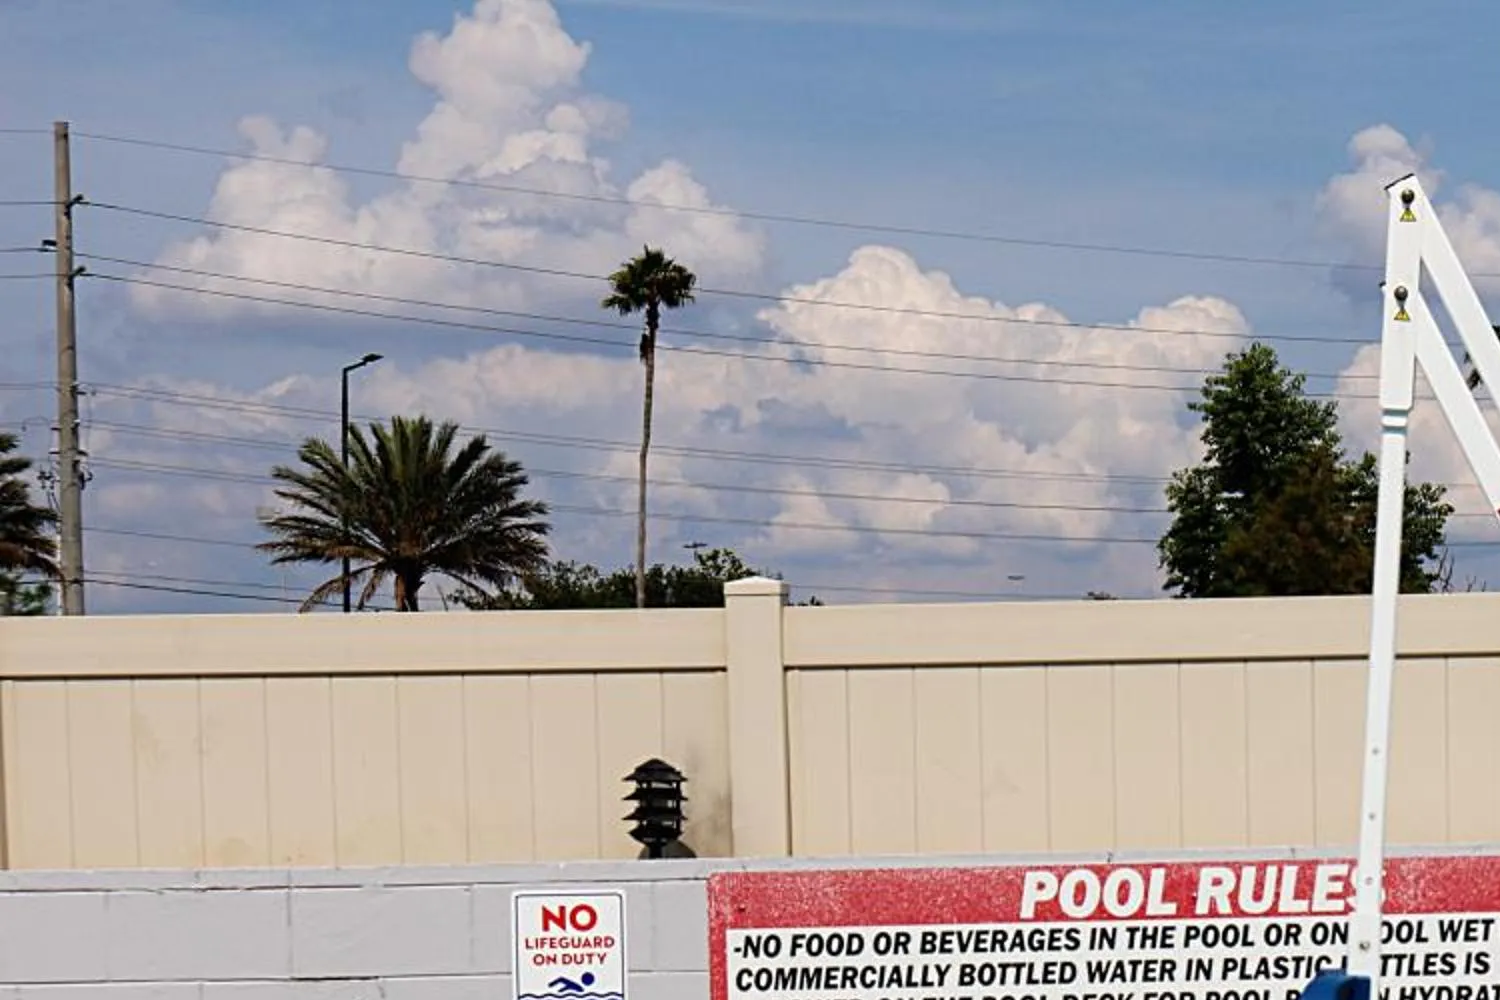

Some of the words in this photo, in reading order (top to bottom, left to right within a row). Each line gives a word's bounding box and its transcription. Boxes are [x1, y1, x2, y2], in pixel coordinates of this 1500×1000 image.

[1020, 867, 1178, 919] POOL
[542, 904, 597, 932] NO
[525, 935, 615, 950] LIFEGUARD
[789, 932, 865, 957] FOOD
[873, 931, 912, 956] OR
[919, 927, 1081, 955] BEVERAGES
[1089, 927, 1117, 951] IN
[1126, 925, 1177, 950] THE
[1183, 923, 1255, 949] POOL
[1263, 923, 1302, 947] OR
[1310, 922, 1349, 946] ON
[1381, 919, 1429, 945] OOL
[1438, 918, 1495, 943] WET
[533, 954, 557, 966] ON
[562, 952, 607, 965] DUTY
[735, 963, 952, 992] COMMERCIALLY
[958, 961, 1077, 987] BOTTLED
[1086, 959, 1177, 984] WATER
[1185, 958, 1213, 982] IN
[1464, 951, 1490, 975] IS
